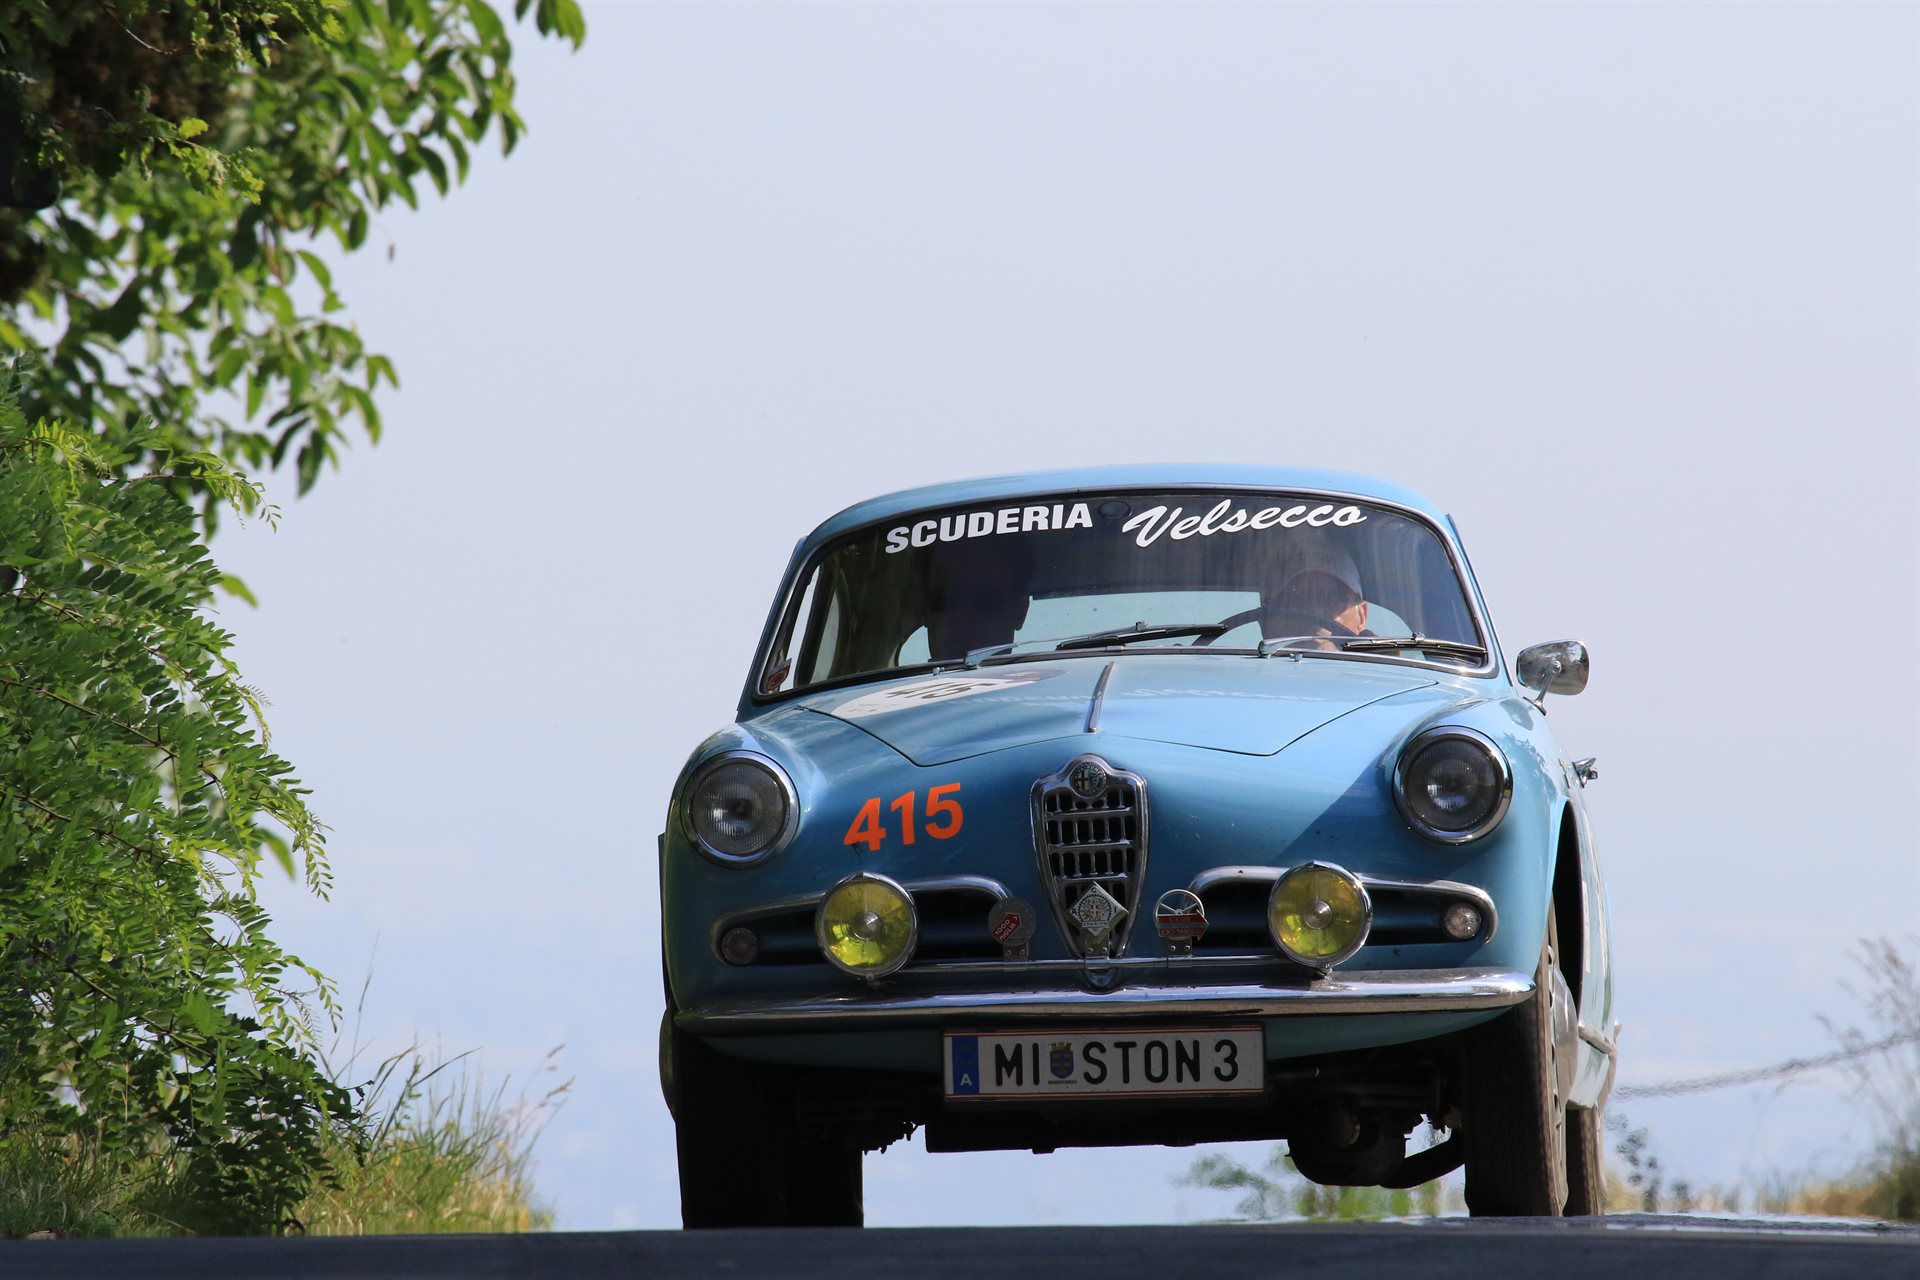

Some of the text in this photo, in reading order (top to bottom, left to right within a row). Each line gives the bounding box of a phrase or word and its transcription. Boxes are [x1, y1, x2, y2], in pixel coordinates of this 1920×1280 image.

[885, 499, 1367, 555] SCUDERIA Velsecco
[844, 782, 964, 851] 415
[959, 1073, 973, 1086] A
[995, 1039, 1239, 1087] MI STON 3
